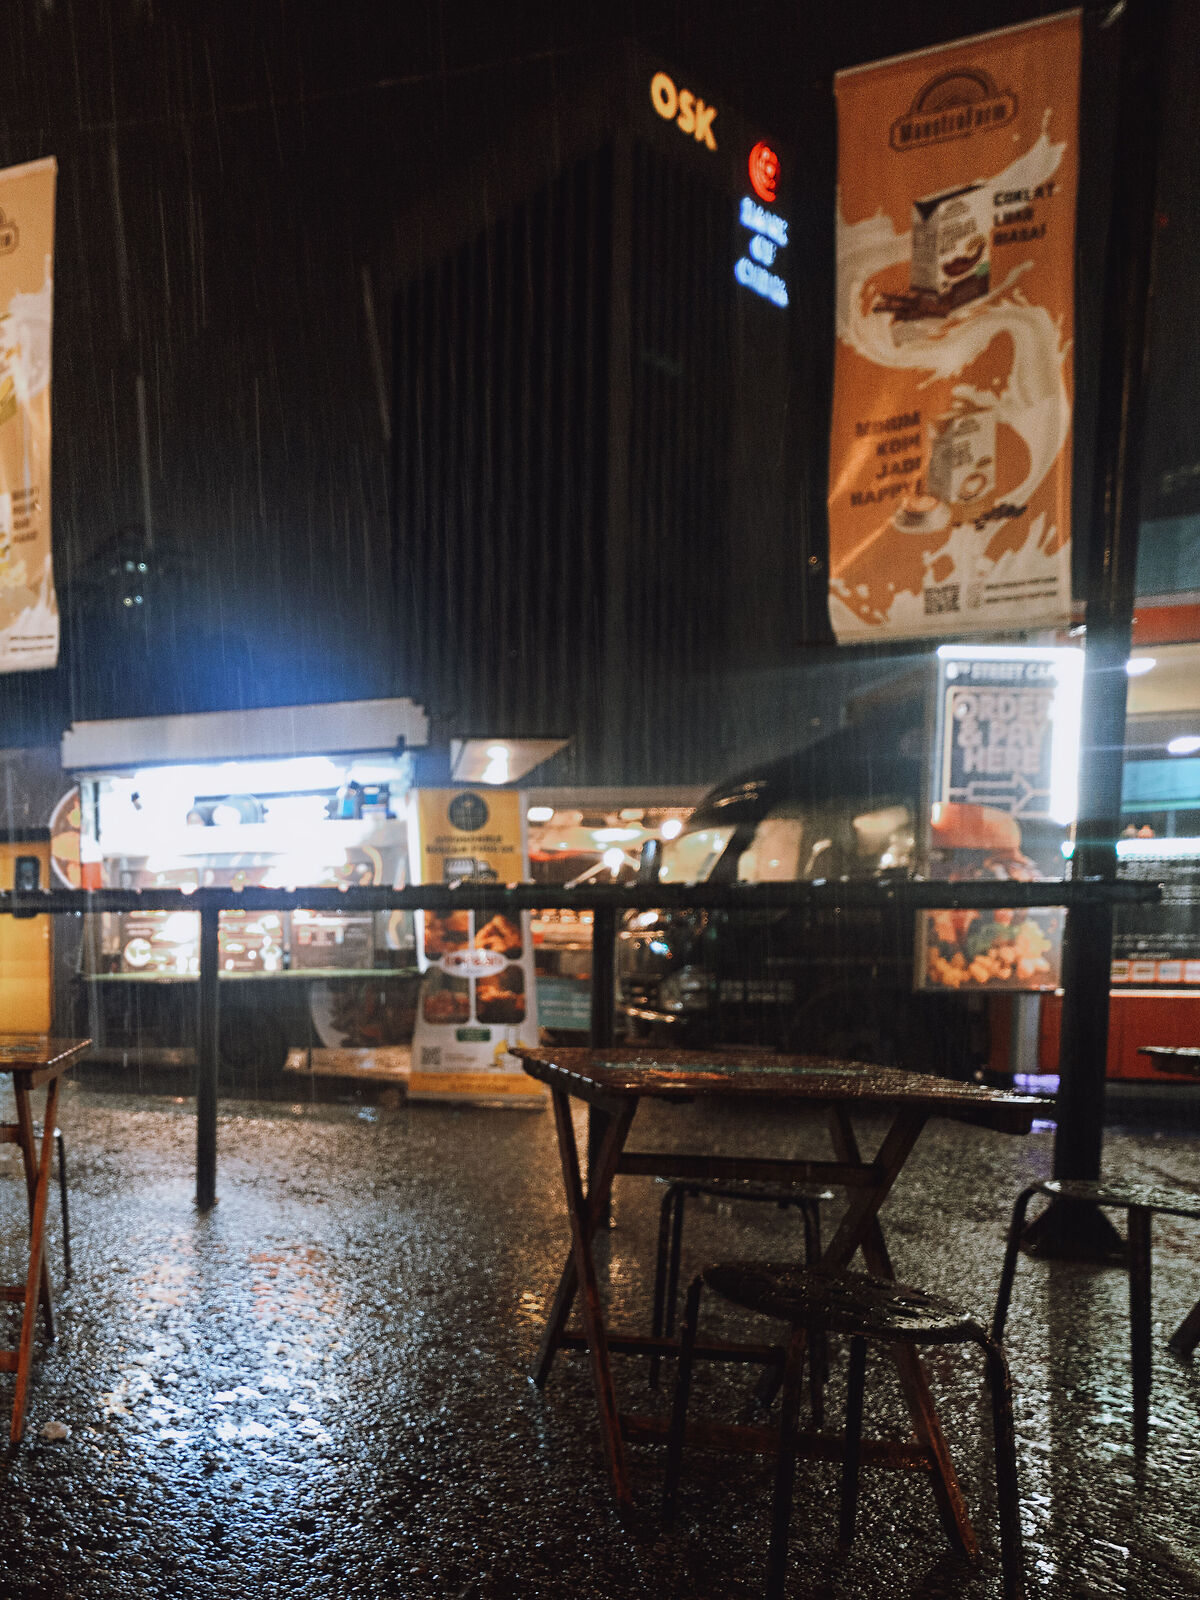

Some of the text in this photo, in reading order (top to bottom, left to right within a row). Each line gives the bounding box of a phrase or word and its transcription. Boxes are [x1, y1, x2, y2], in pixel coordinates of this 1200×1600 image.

[650, 72, 718, 152] OSK
[971, 662, 1026, 680] STREET
[957, 719, 1048, 747] & PAY
[962, 745, 1041, 774] HERE
